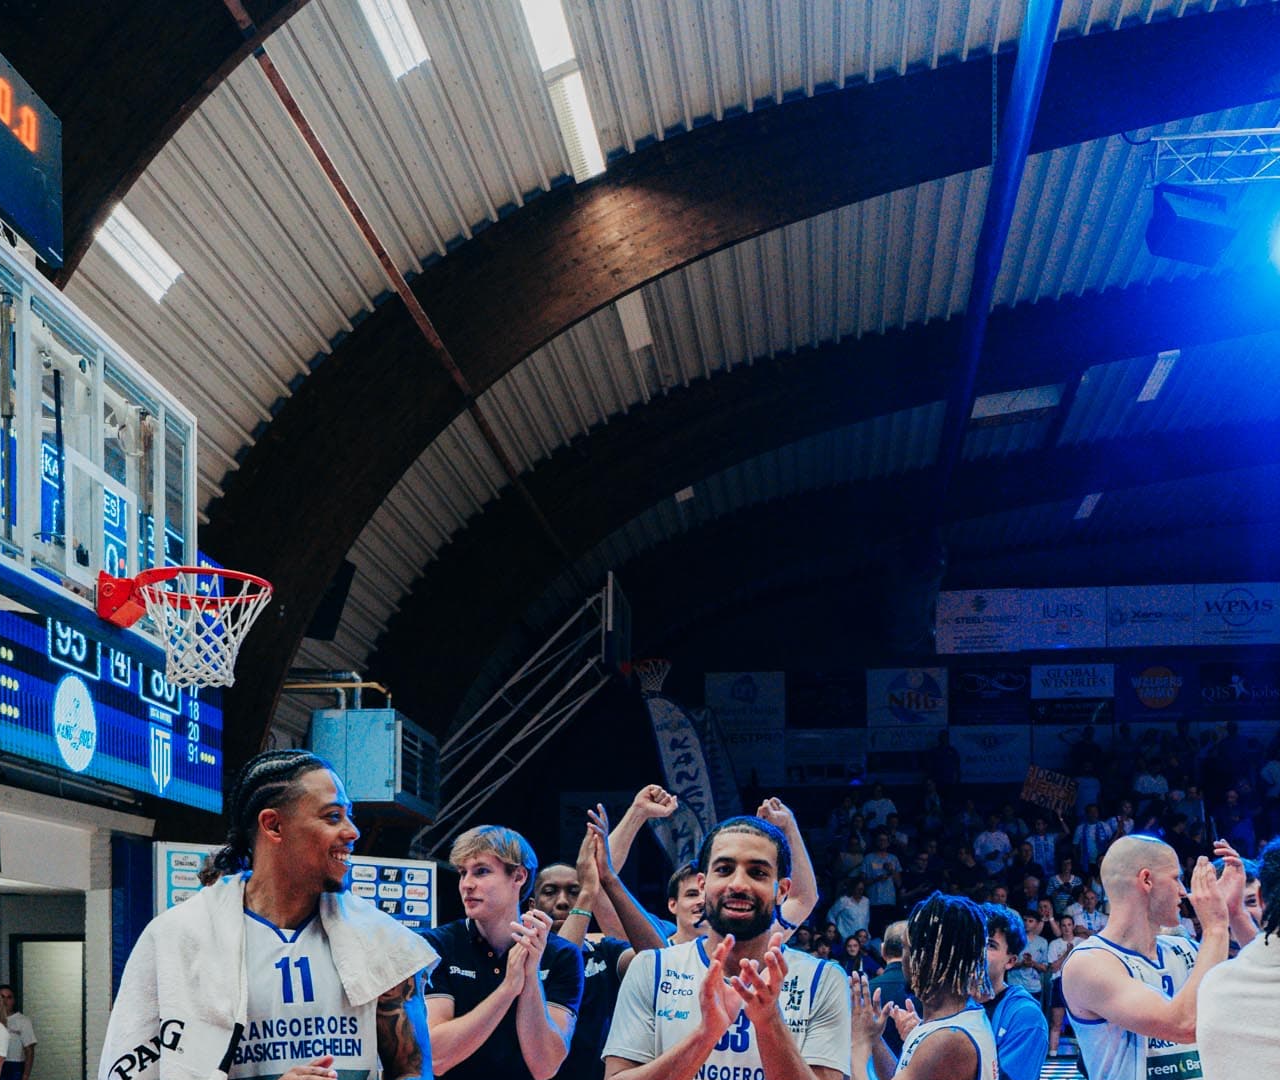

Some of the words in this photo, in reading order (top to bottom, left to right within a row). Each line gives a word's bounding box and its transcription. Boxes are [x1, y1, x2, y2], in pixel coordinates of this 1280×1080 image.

[188, 722, 200, 743] 20
[274, 955, 315, 1005] 11
[232, 1040, 291, 1067] BASKET
[290, 1037, 363, 1062] MECHELEN
